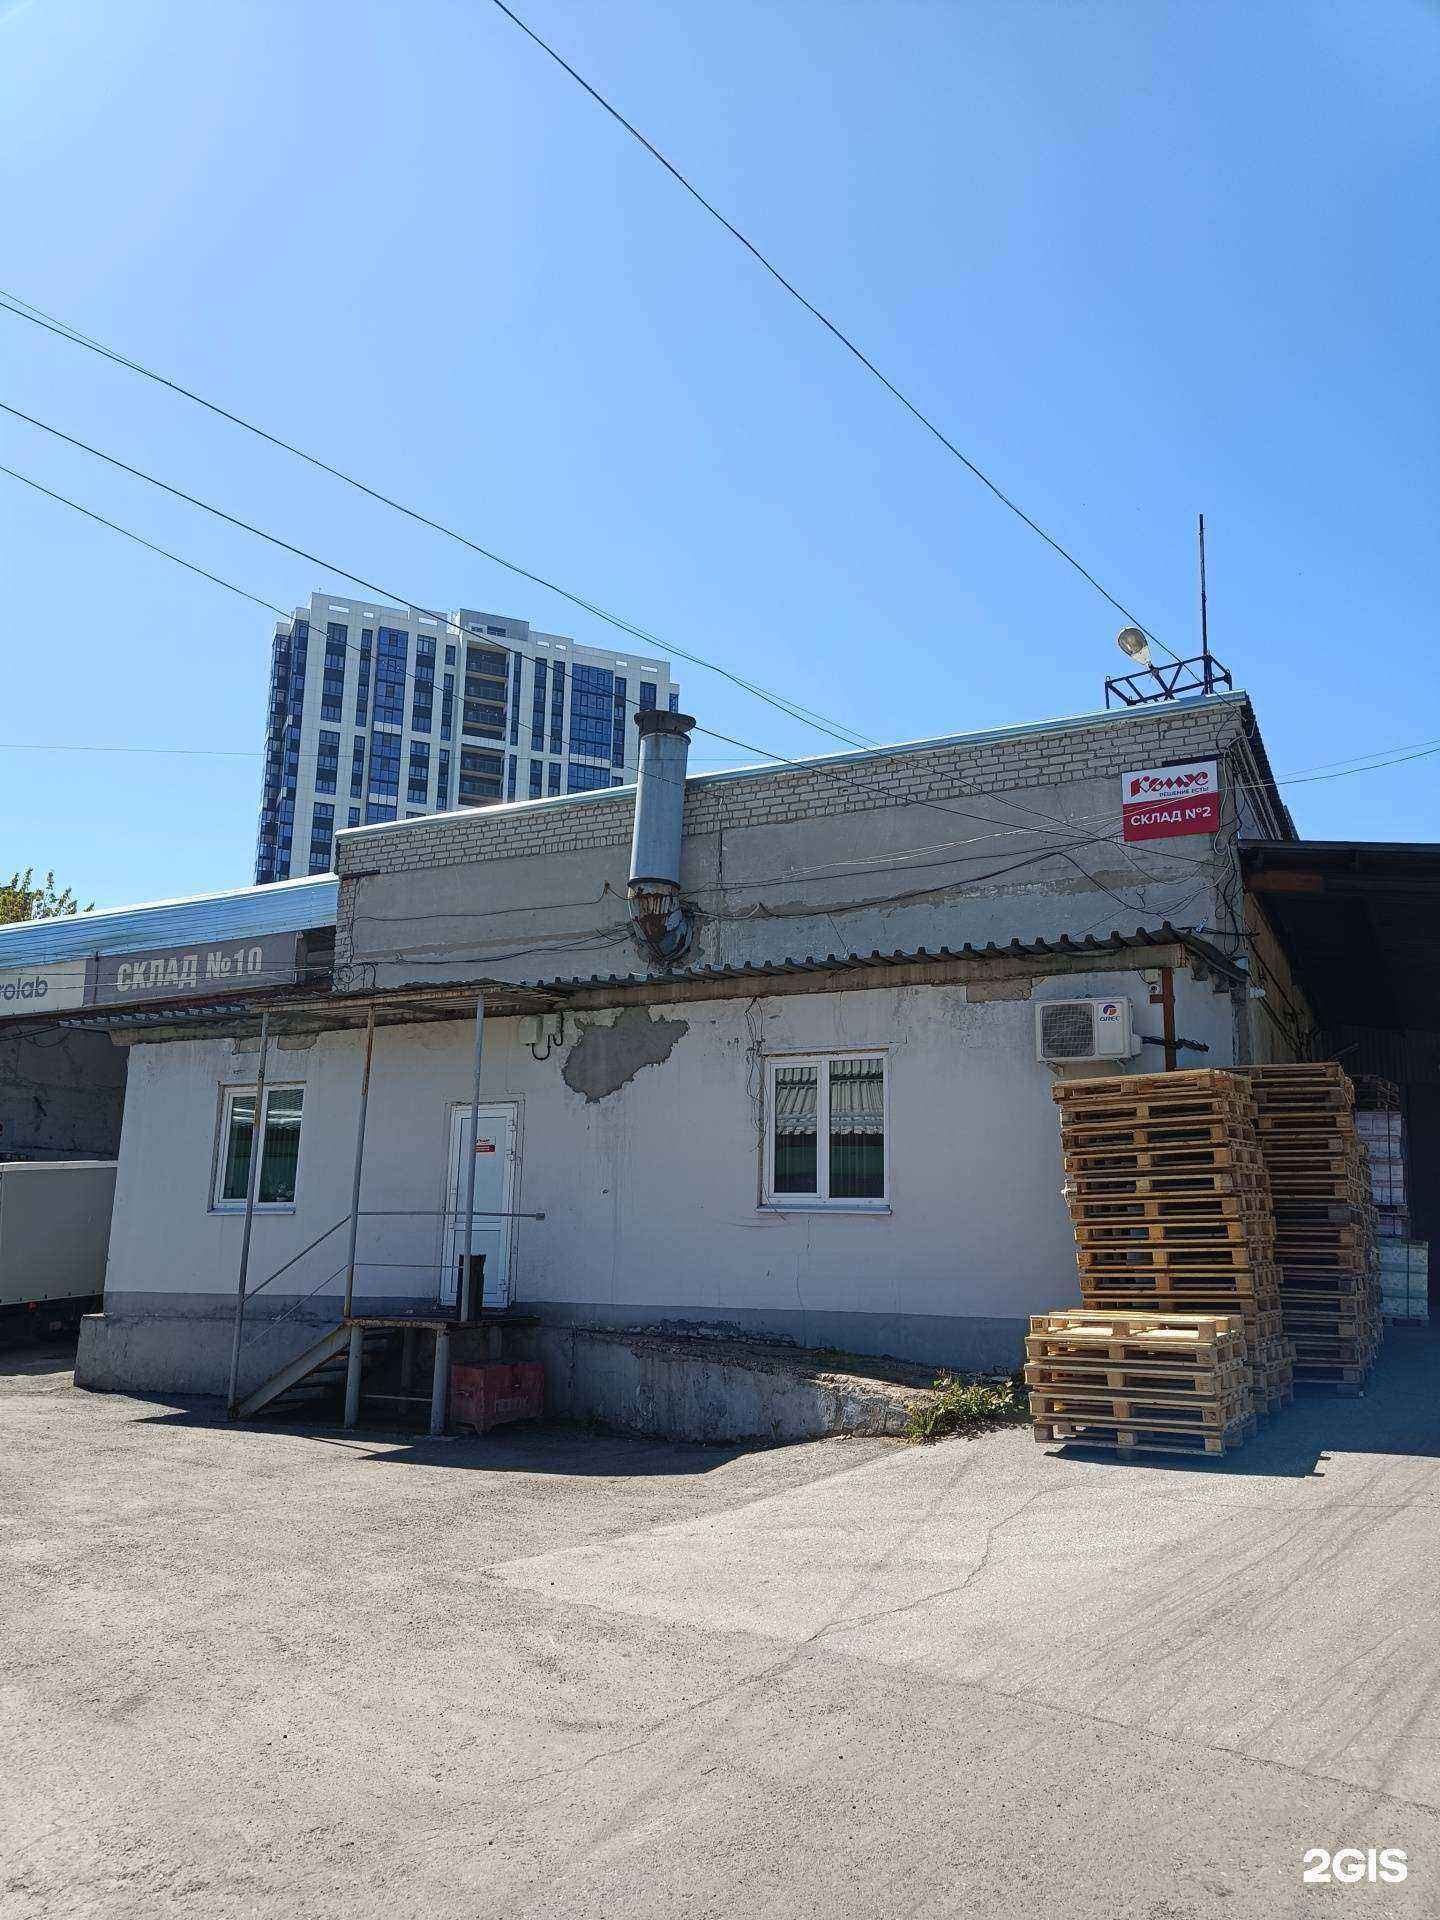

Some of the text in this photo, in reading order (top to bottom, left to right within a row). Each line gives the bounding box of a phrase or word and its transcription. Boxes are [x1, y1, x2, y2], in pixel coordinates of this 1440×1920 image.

[1130, 806, 1212, 826] СКЛАД №2
[117, 946, 263, 992] СКЛАД №10
